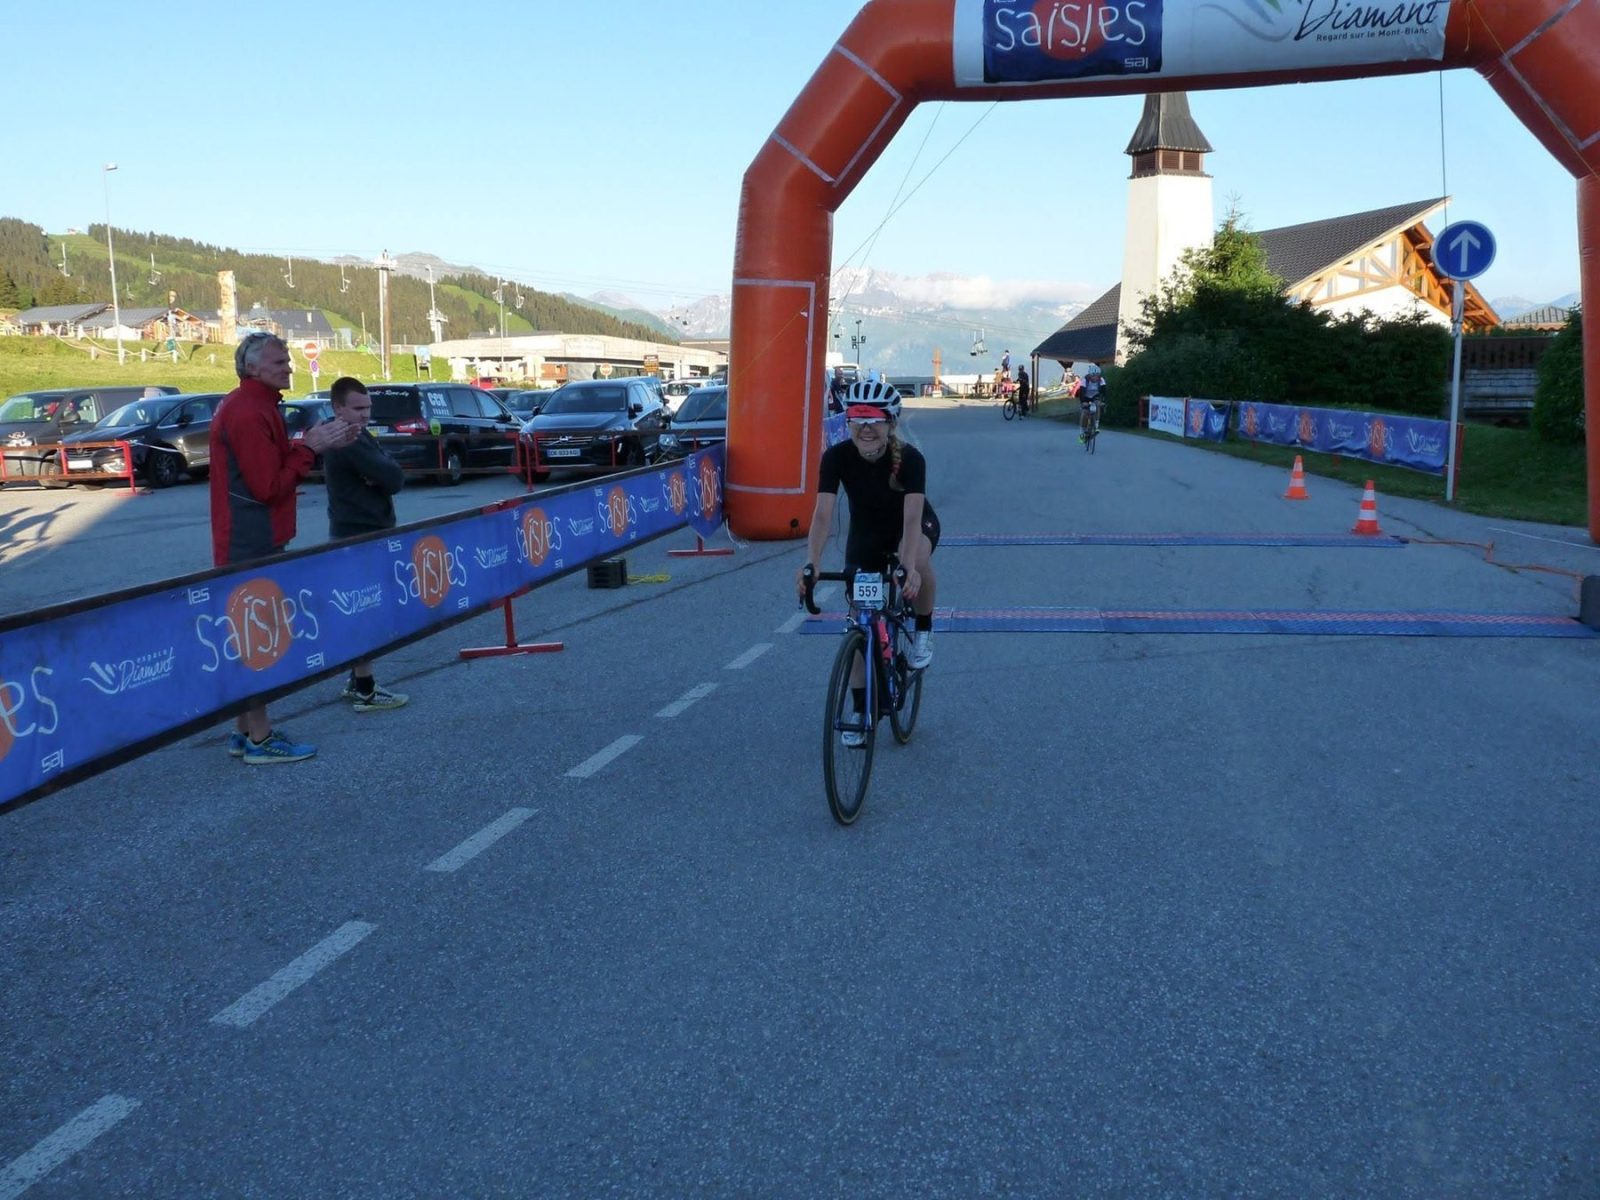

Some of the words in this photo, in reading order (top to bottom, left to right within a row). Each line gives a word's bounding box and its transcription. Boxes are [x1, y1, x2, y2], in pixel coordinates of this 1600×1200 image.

[1294, 0, 1450, 41] Diamant
[1316, 33, 1348, 43] Regard
[1350, 31, 1364, 40] sur
[1367, 29, 1376, 39] le
[1378, 27, 1430, 37] Mont-Blanc
[187, 587, 211, 606] les
[858, 585, 878, 598] 559
[118, 646, 176, 692] Diamant
